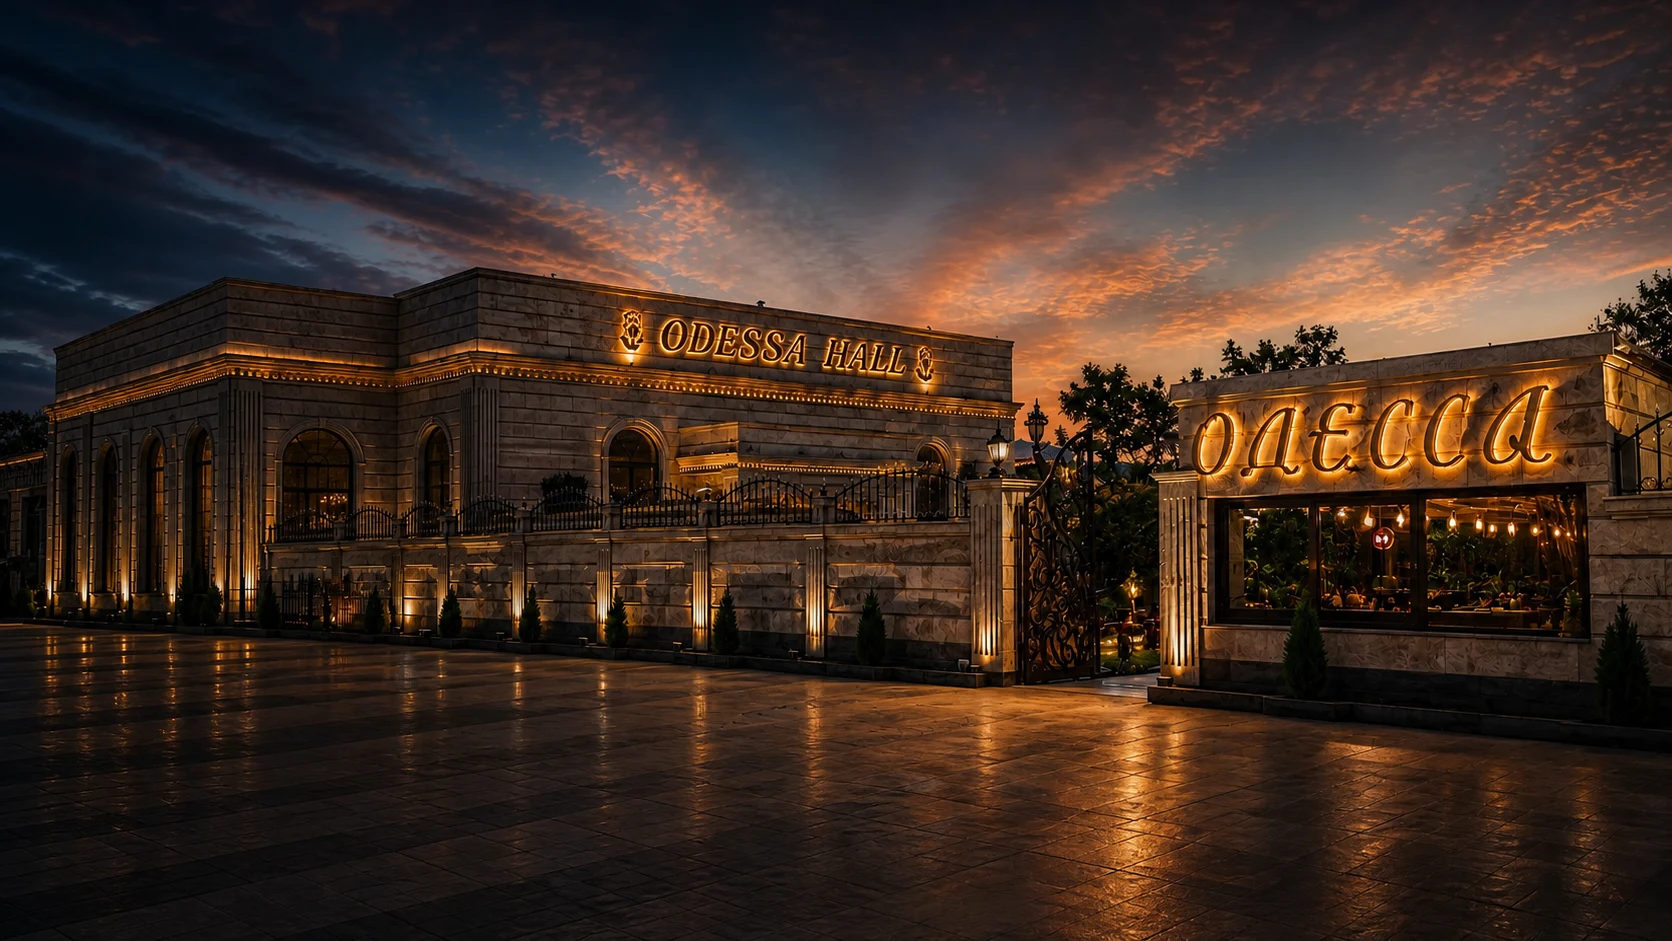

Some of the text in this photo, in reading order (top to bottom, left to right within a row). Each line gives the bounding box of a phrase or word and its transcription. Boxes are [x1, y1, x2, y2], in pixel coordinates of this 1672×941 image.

[660, 318, 906, 375] ODESSA HALL
[1191, 385, 1553, 477] ОДЕССА
